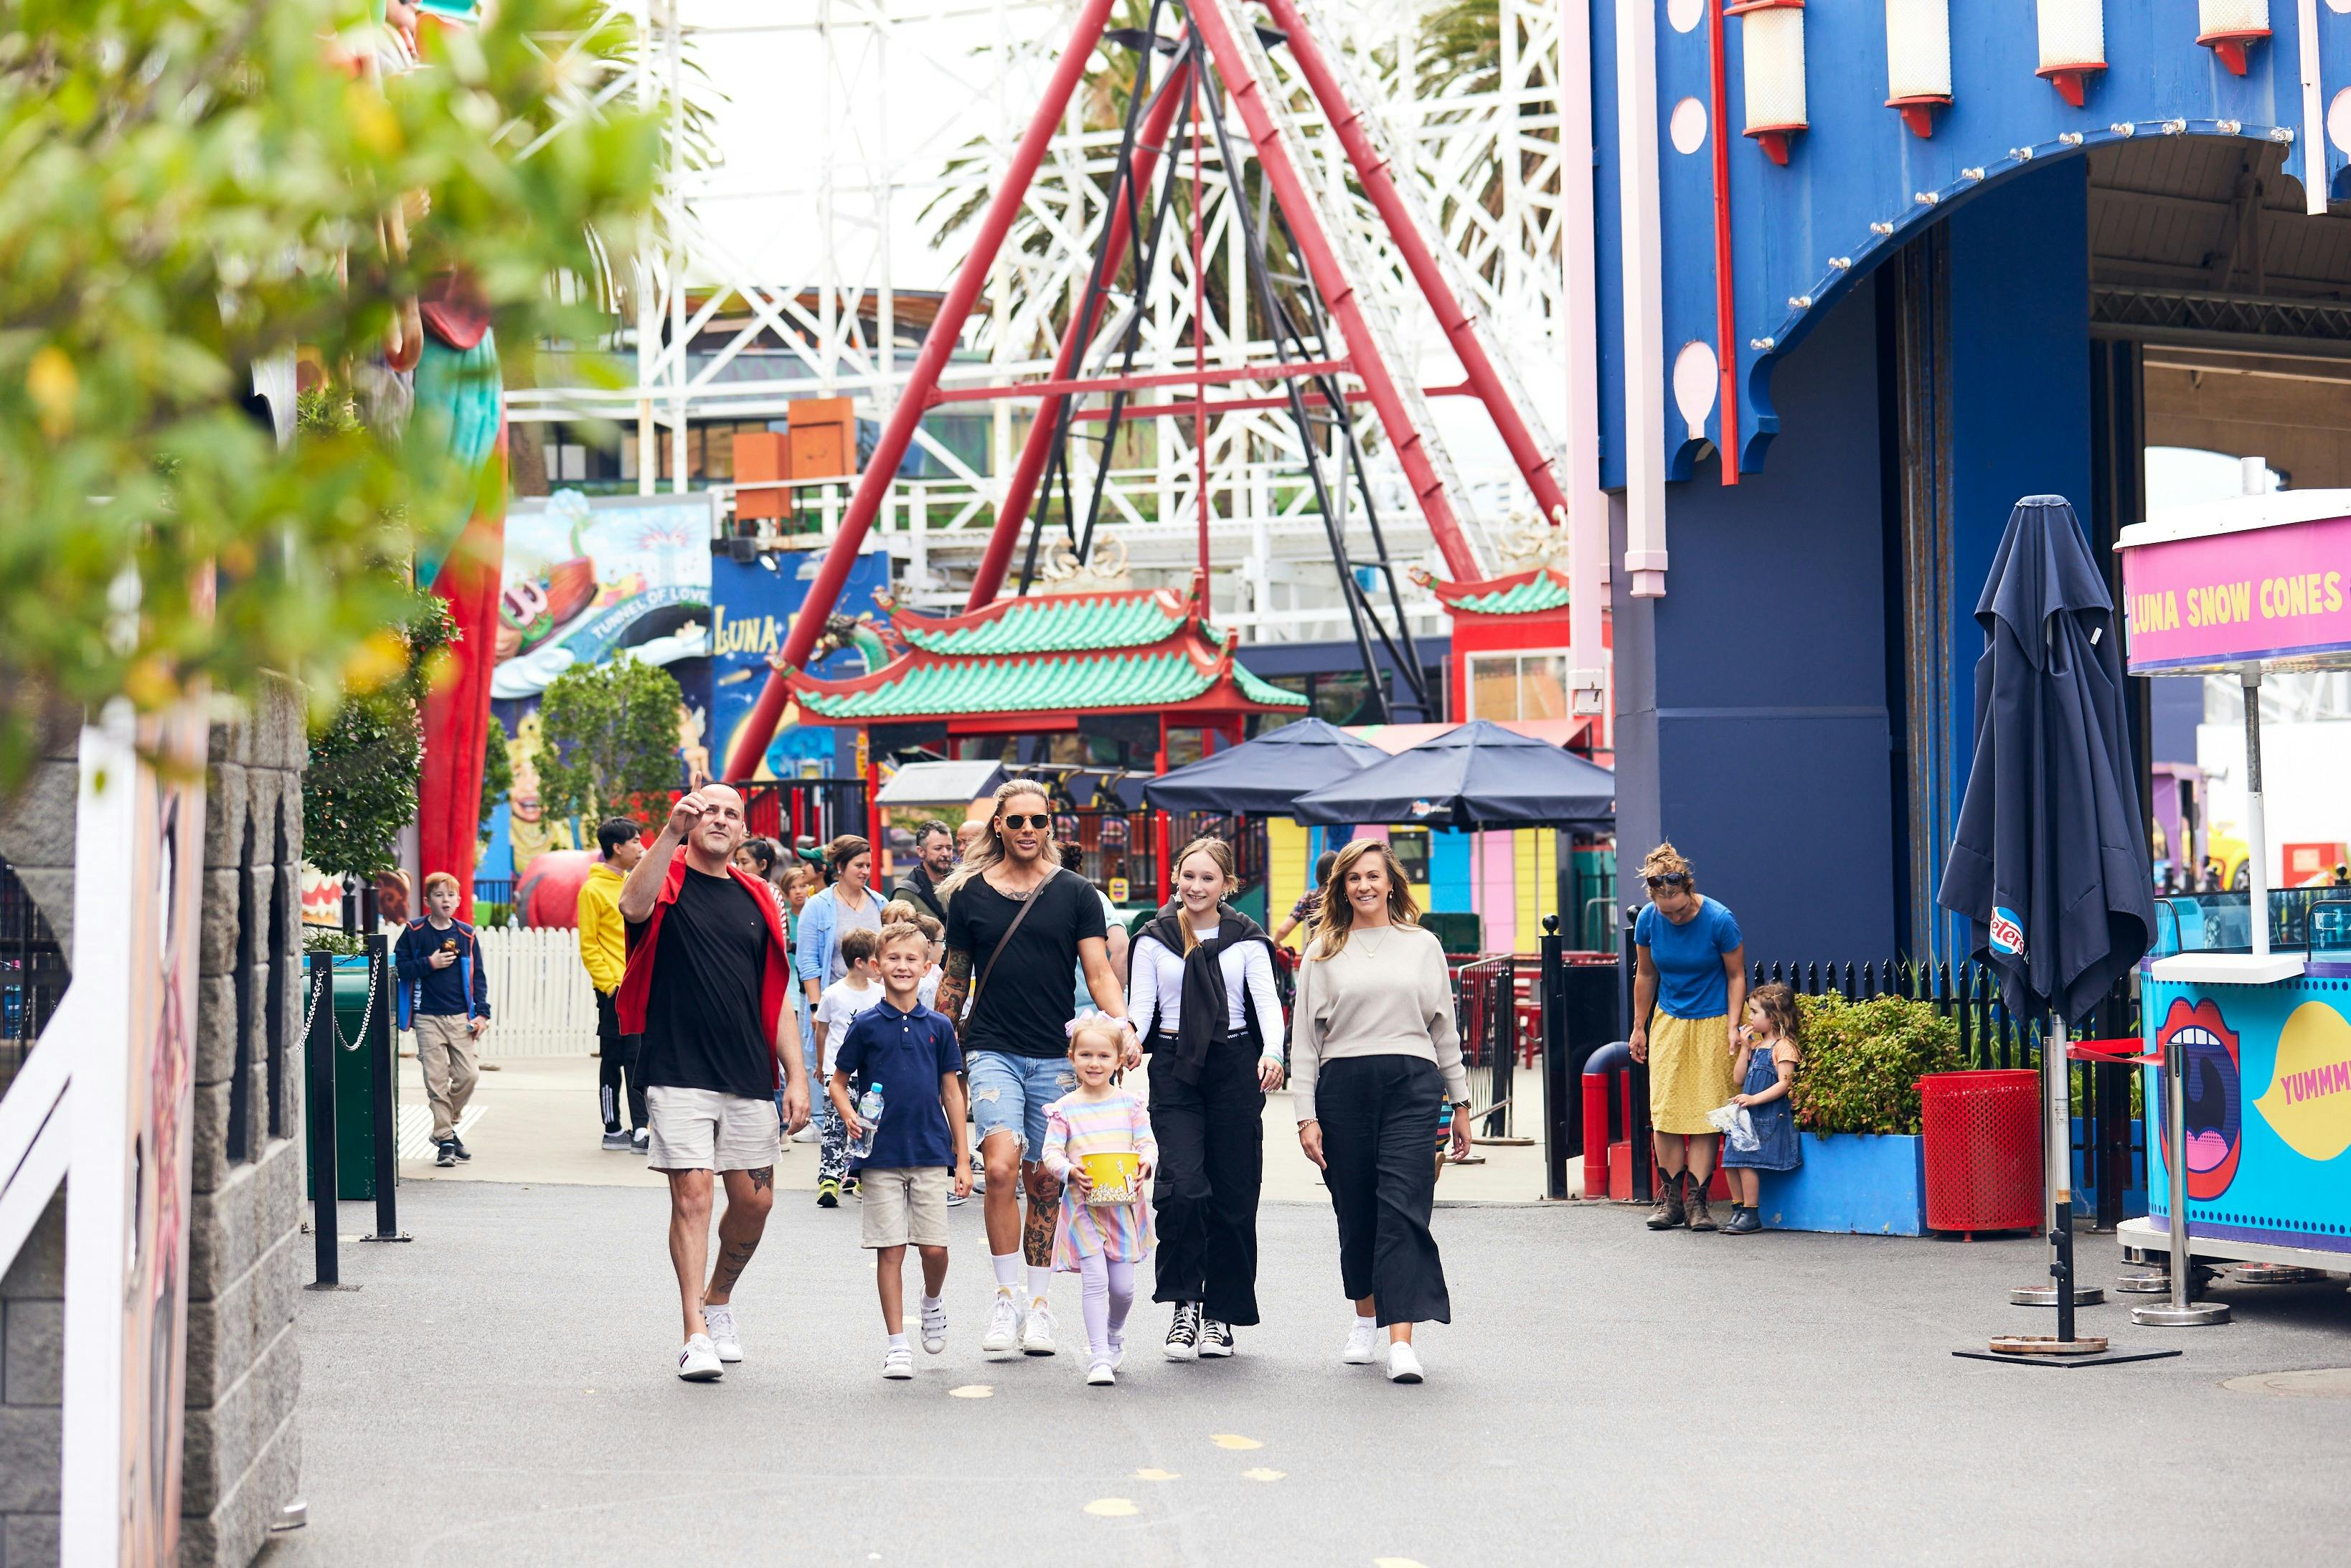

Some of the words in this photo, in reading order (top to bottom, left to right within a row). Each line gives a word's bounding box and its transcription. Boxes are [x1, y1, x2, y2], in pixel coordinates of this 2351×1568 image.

[591, 599, 646, 639] TUNNEL
[647, 590, 667, 605] OF
[669, 587, 709, 603] LOVE
[2131, 590, 2180, 635] LUNA
[2187, 581, 2251, 628] SNOW
[2260, 571, 2343, 619] CONES
[2280, 1059, 2351, 1105] YUMMM
